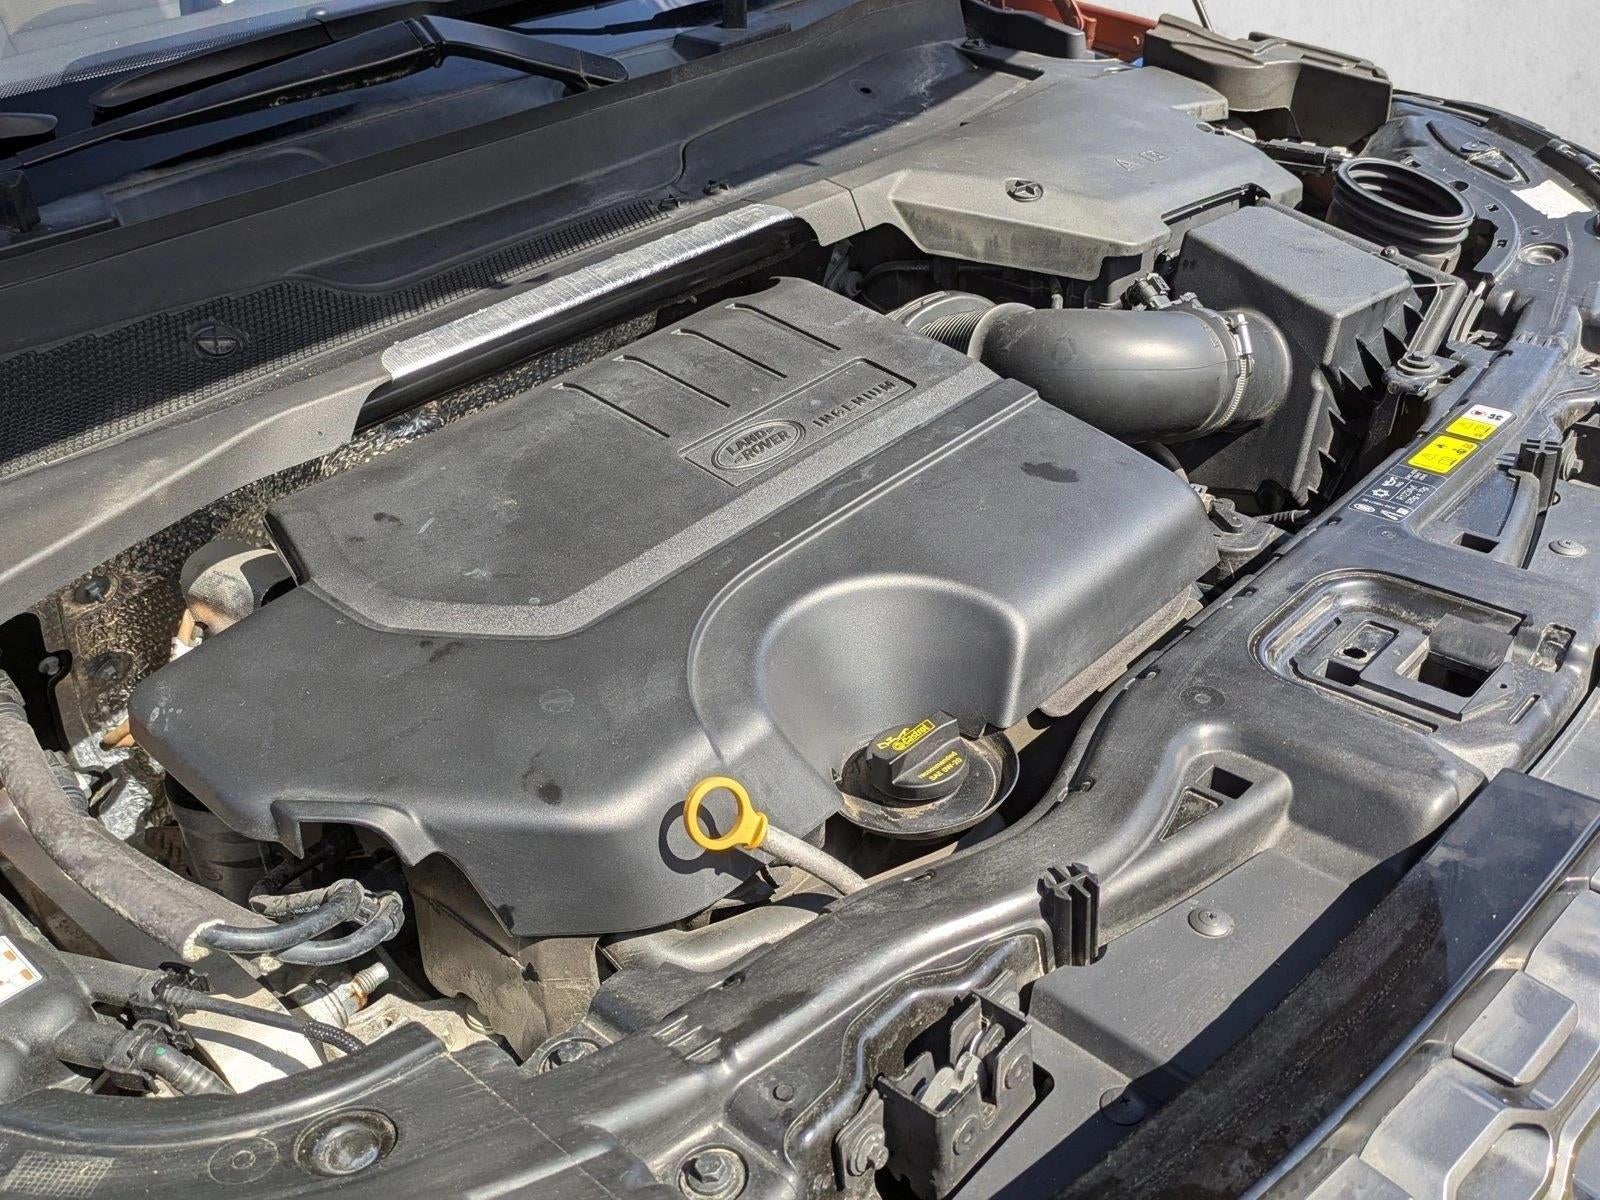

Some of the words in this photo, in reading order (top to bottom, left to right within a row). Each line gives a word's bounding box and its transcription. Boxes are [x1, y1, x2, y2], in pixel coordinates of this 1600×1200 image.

[812, 380, 896, 427] INGENIUM
[902, 724, 930, 744] Castrol
[918, 750, 958, 779] recommended
[928, 769, 943, 781] SAE
[942, 757, 963, 774] 0W-20
